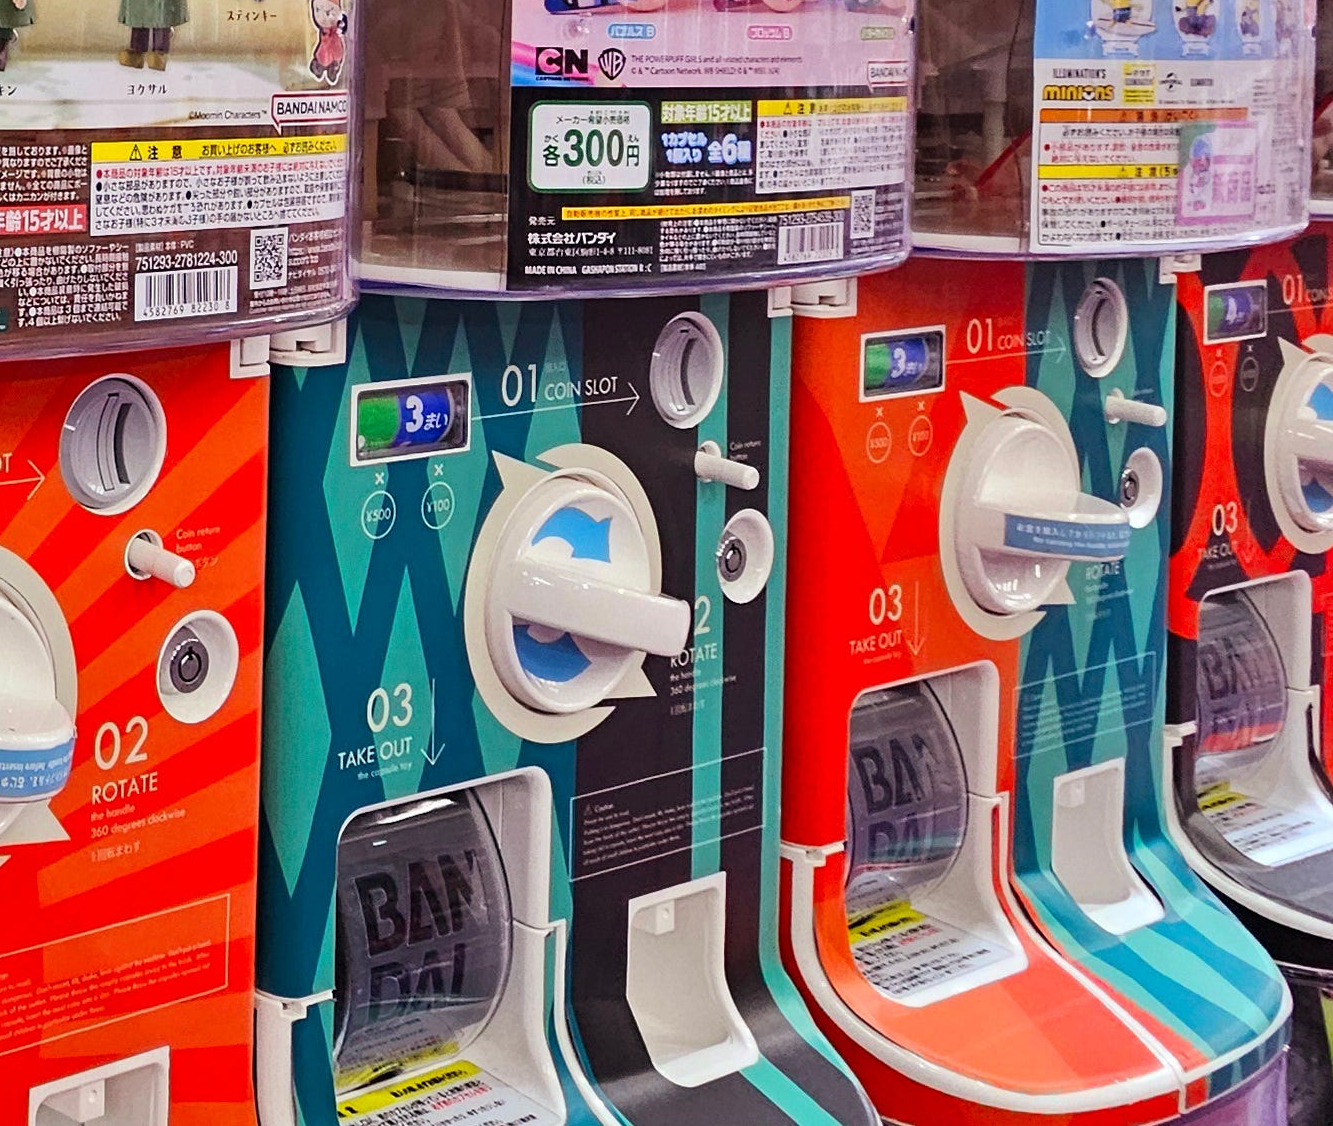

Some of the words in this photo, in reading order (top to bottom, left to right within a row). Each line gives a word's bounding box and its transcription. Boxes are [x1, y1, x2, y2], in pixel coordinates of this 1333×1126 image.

[536, 47, 589, 75] CN
[127, 83, 168, 96] ヨクサル
[277, 100, 318, 115] BANDAI
[527, 231, 617, 246] 株式会社バンダイ
[966, 318, 993, 355] 01
[501, 363, 537, 408] 01
[544, 381, 582, 402] COIN
[584, 376, 619, 396] SLOT
[1211, 501, 1239, 537] 03
[868, 583, 903, 626] 03
[849, 634, 876, 655] TAKE
[878, 629, 903, 649] OUT
[366, 682, 413, 734] 03
[94, 716, 149, 771] 02
[337, 745, 376, 771] TAKE
[379, 735, 413, 761] OUT
[91, 772, 159, 806] ROTATE
